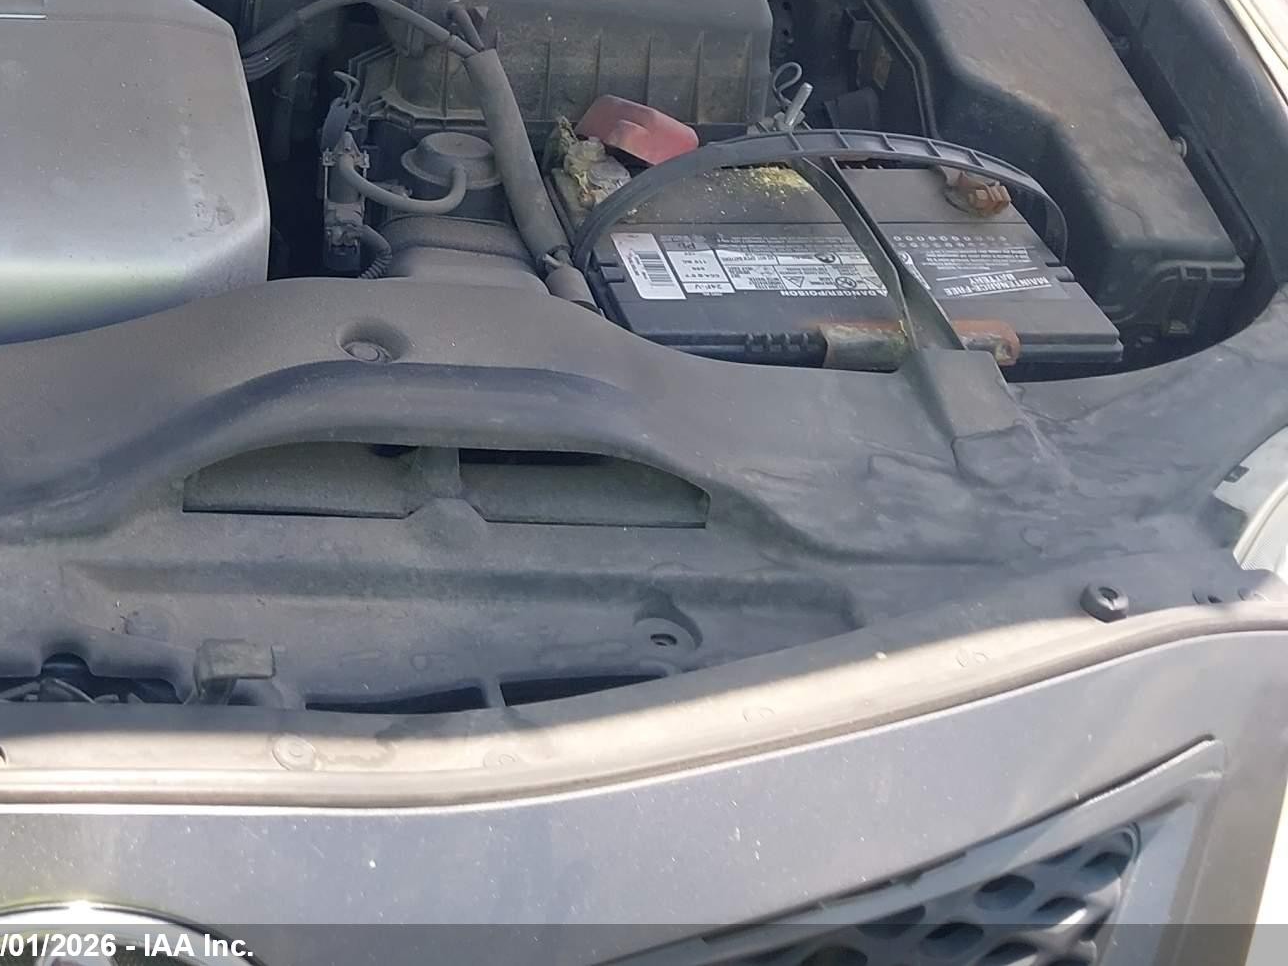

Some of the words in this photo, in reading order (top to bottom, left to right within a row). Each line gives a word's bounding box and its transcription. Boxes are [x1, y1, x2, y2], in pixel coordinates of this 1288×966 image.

[968, 273, 1017, 285] BATTERY
[943, 275, 1050, 297] MAINTENANCE-FREE
[779, 289, 880, 298] DANGER/POISON
